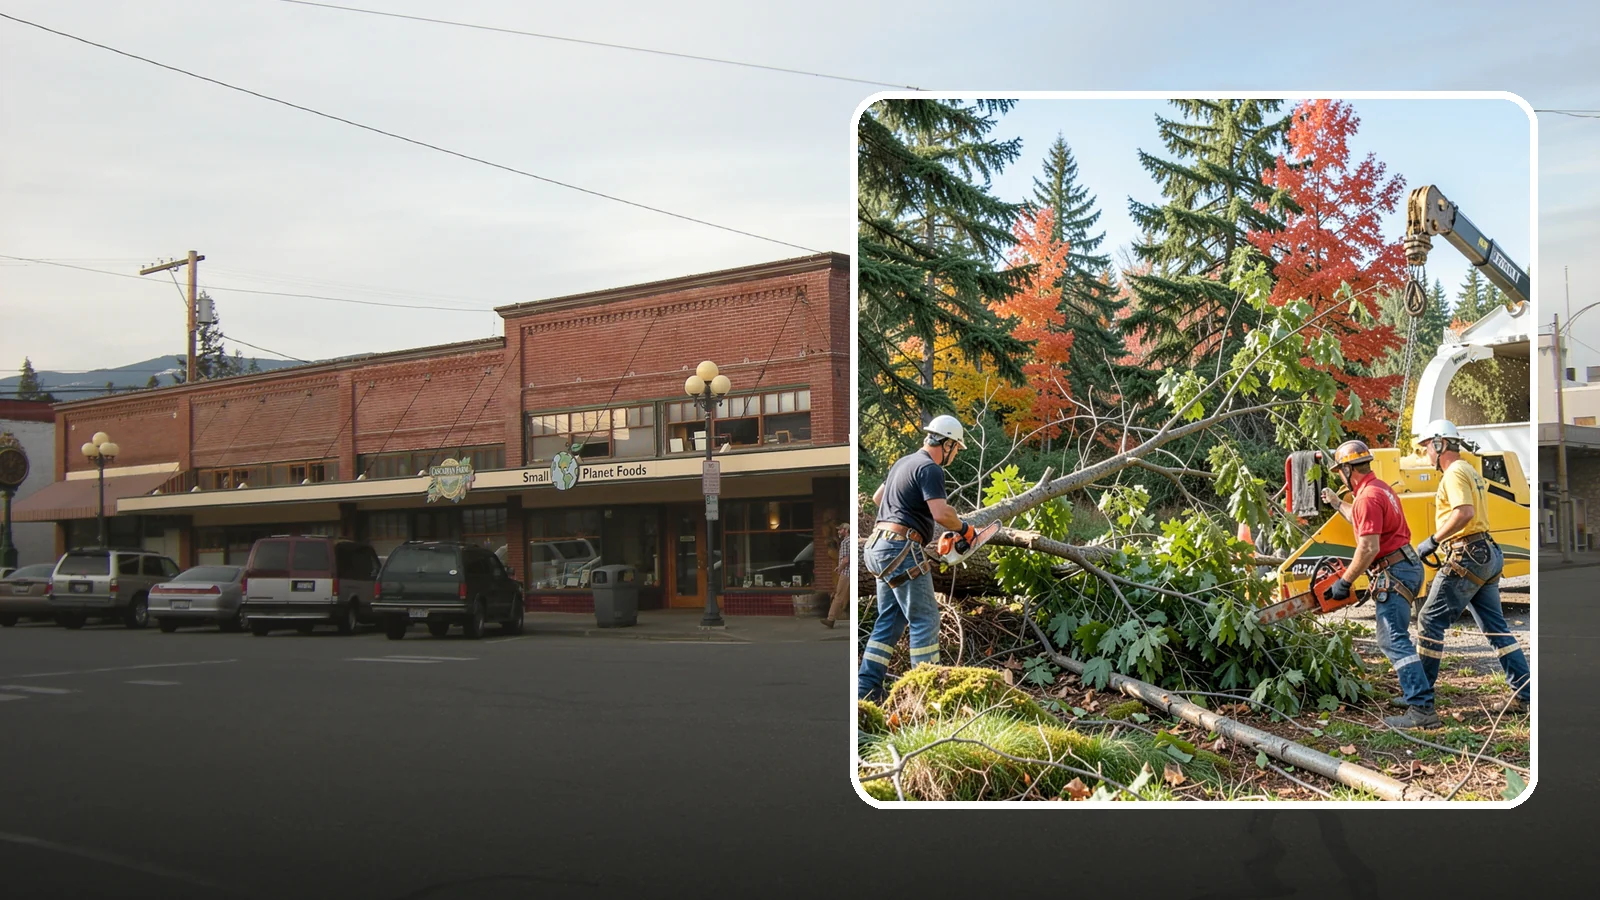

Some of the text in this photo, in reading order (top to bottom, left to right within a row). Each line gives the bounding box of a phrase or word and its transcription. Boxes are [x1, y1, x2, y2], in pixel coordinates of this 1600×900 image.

[523, 464, 647, 483] Small Planet Foods
